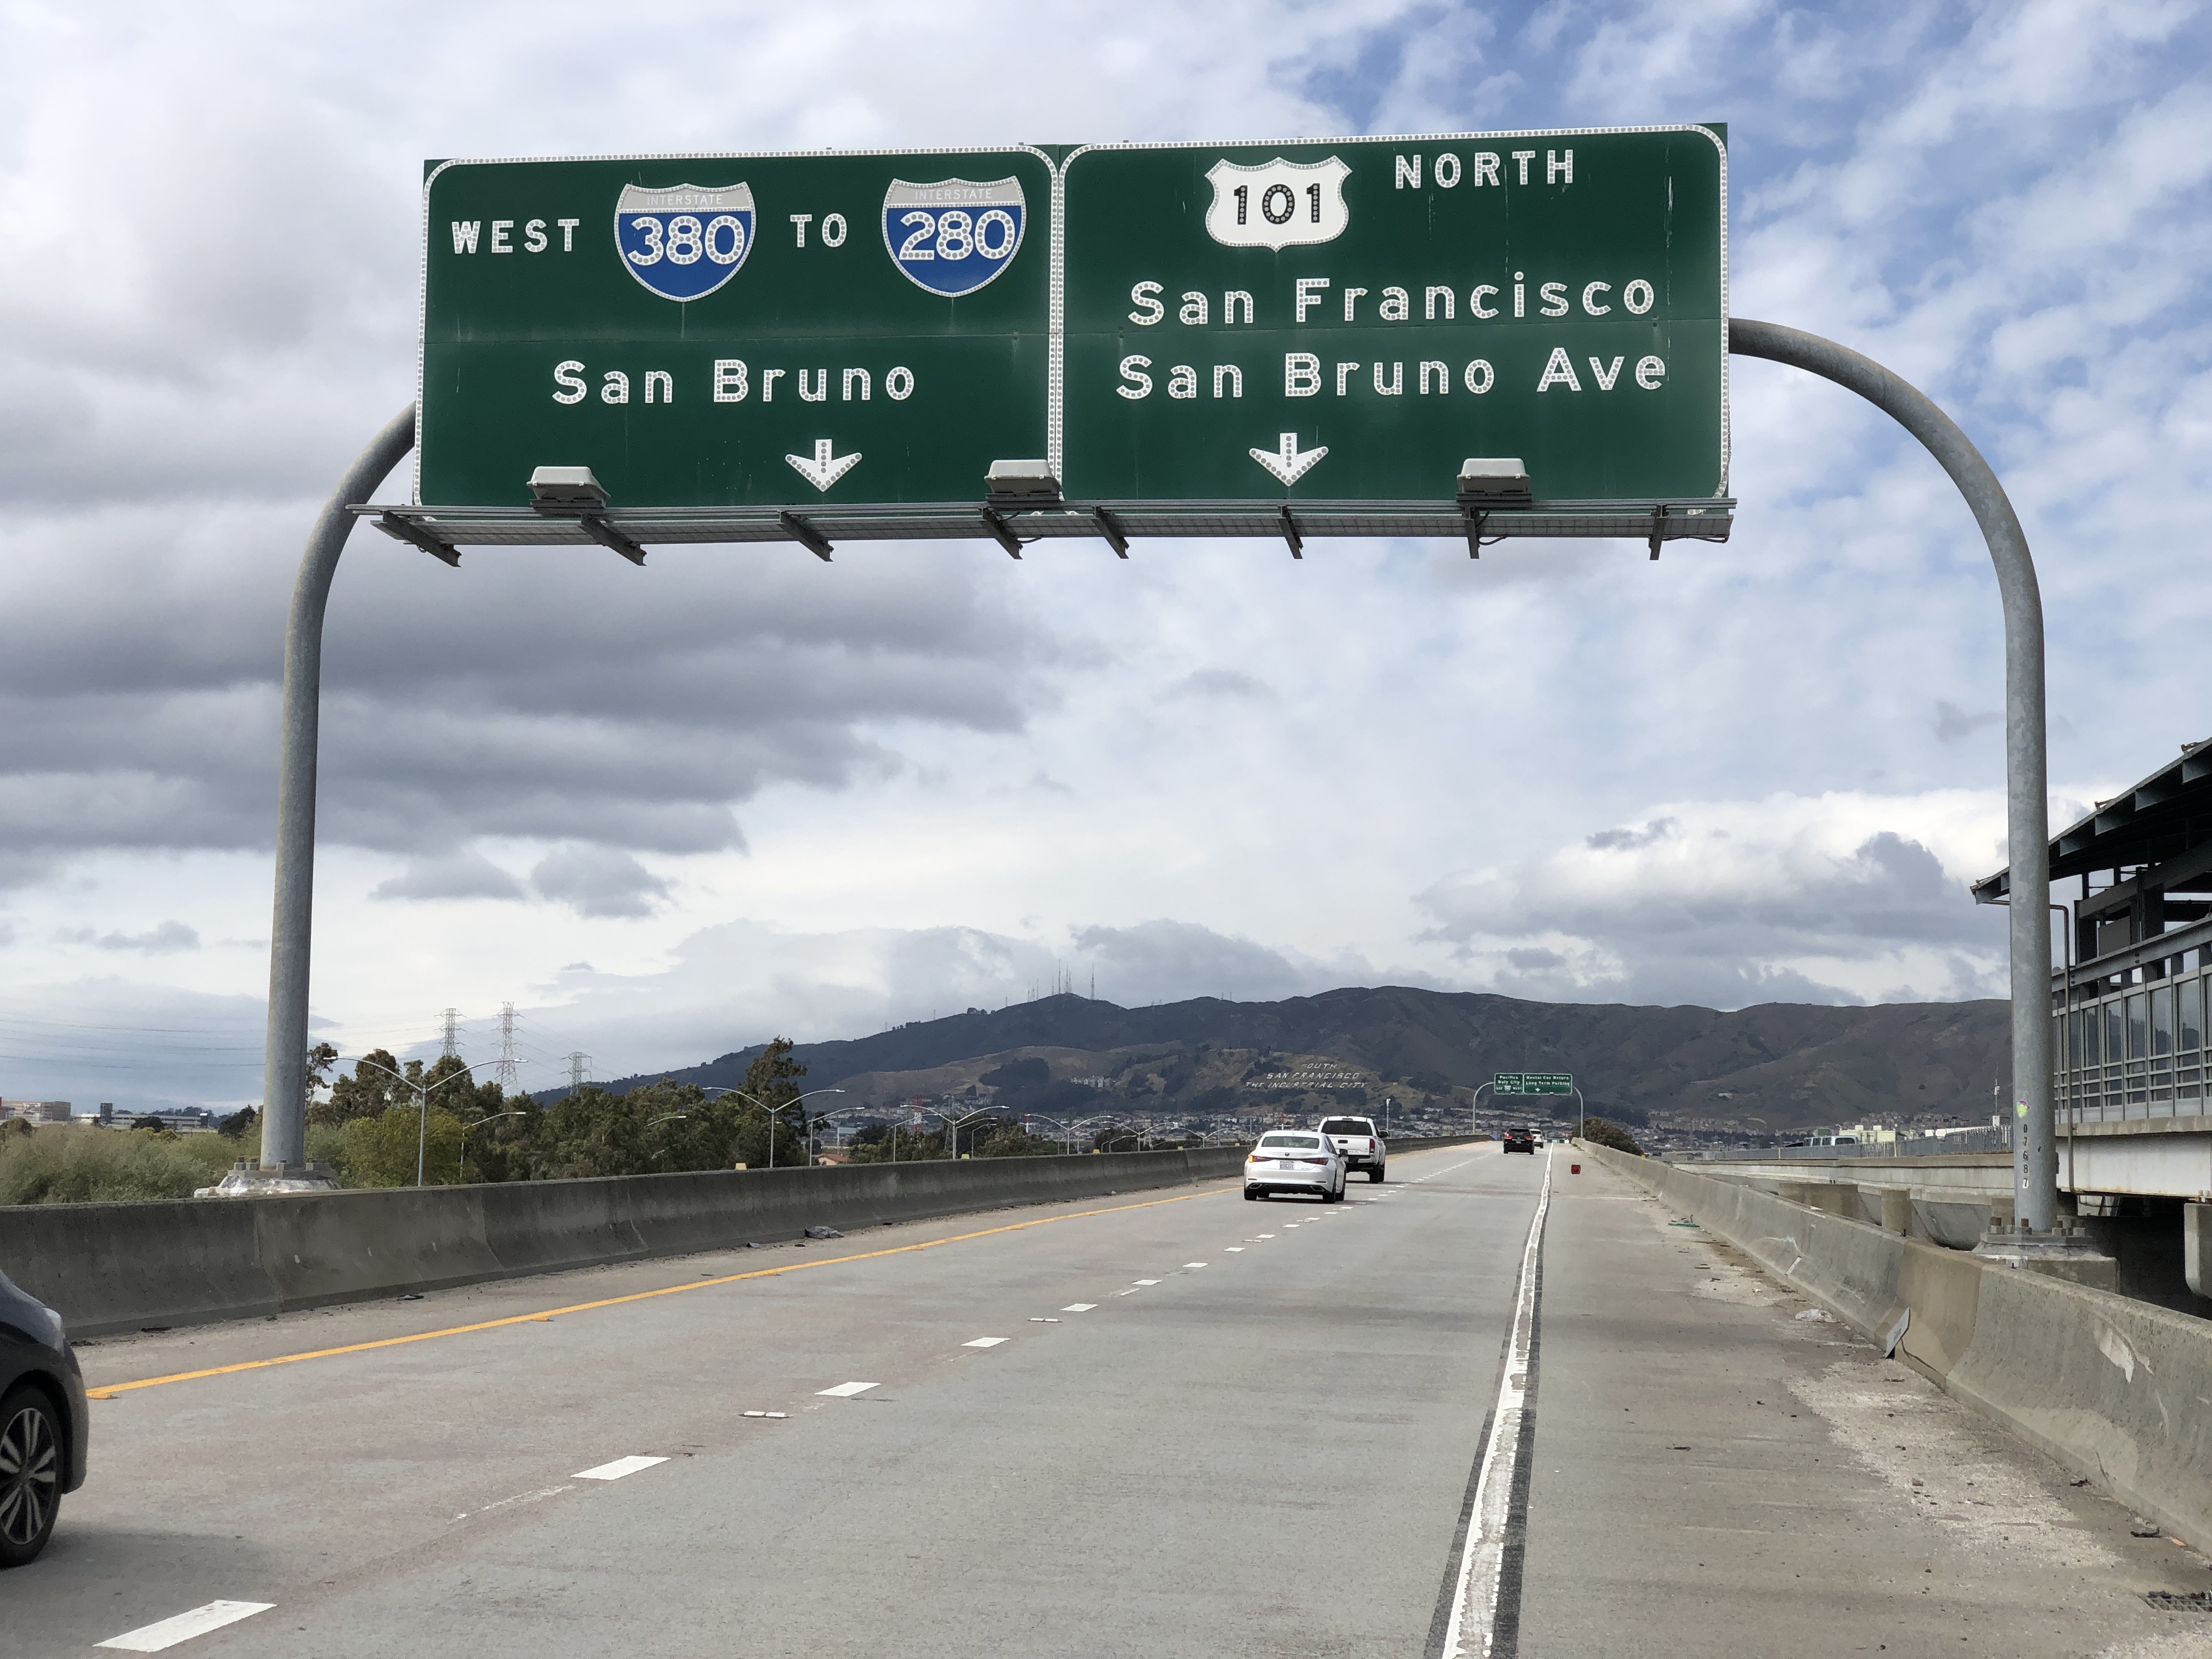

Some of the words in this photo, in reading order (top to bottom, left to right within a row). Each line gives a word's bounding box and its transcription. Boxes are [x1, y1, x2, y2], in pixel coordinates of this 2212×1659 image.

[1396, 149, 1573, 189] NORTH
[647, 194, 724, 206] INTERSTATE
[915, 188, 992, 200] INTERSTATE
[1234, 183, 1320, 225] 101
[452, 218, 580, 254] WEST
[627, 215, 745, 266] 380
[791, 213, 847, 247] TO
[899, 210, 1015, 261] 280
[1127, 281, 1254, 326] San
[1296, 271, 1655, 323] Francisco
[552, 360, 673, 404] San
[713, 359, 915, 403] Bruno
[1116, 354, 1243, 399] San
[1285, 352, 1494, 397] Bruno
[1536, 347, 1666, 392] Ave
